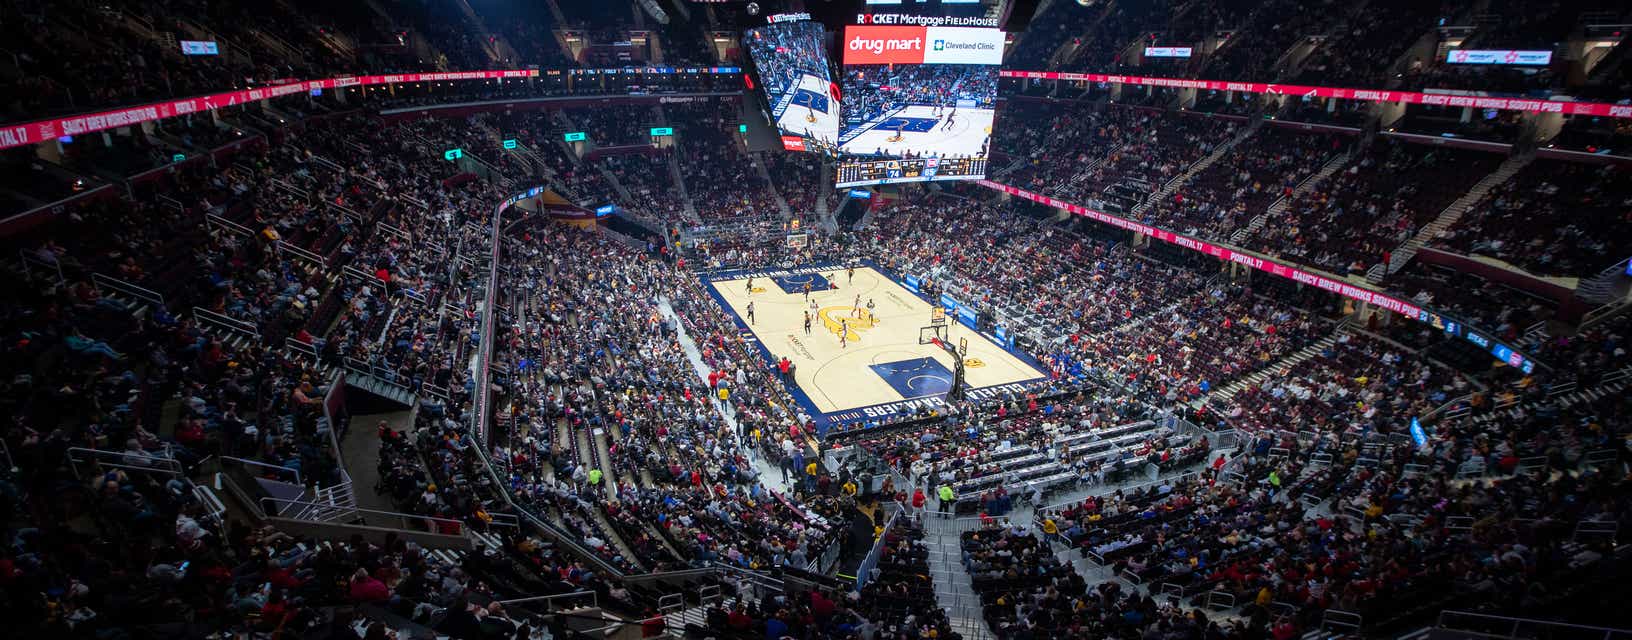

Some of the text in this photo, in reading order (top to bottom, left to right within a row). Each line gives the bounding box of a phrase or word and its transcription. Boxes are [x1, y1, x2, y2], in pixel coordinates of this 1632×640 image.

[857, 14, 899, 24] ROCKET
[900, 14, 944, 26] Mortgage
[850, 36, 921, 54] drug mart
[945, 41, 995, 50] Cleveland Clinic
[1354, 90, 1391, 100] PORTAL 17
[1422, 94, 1563, 112] SAUCY BREW WORKS SOUTH PUB
[16, 127, 28, 144] 17
[889, 170, 899, 178] 74
[1175, 235, 1196, 249] PORTAL
[1230, 252, 1263, 268] PORTAL 17
[1292, 270, 1418, 318] SAUCY BREW WORKS SOUTH PUB
[965, 383, 1027, 401] CLEVELA
